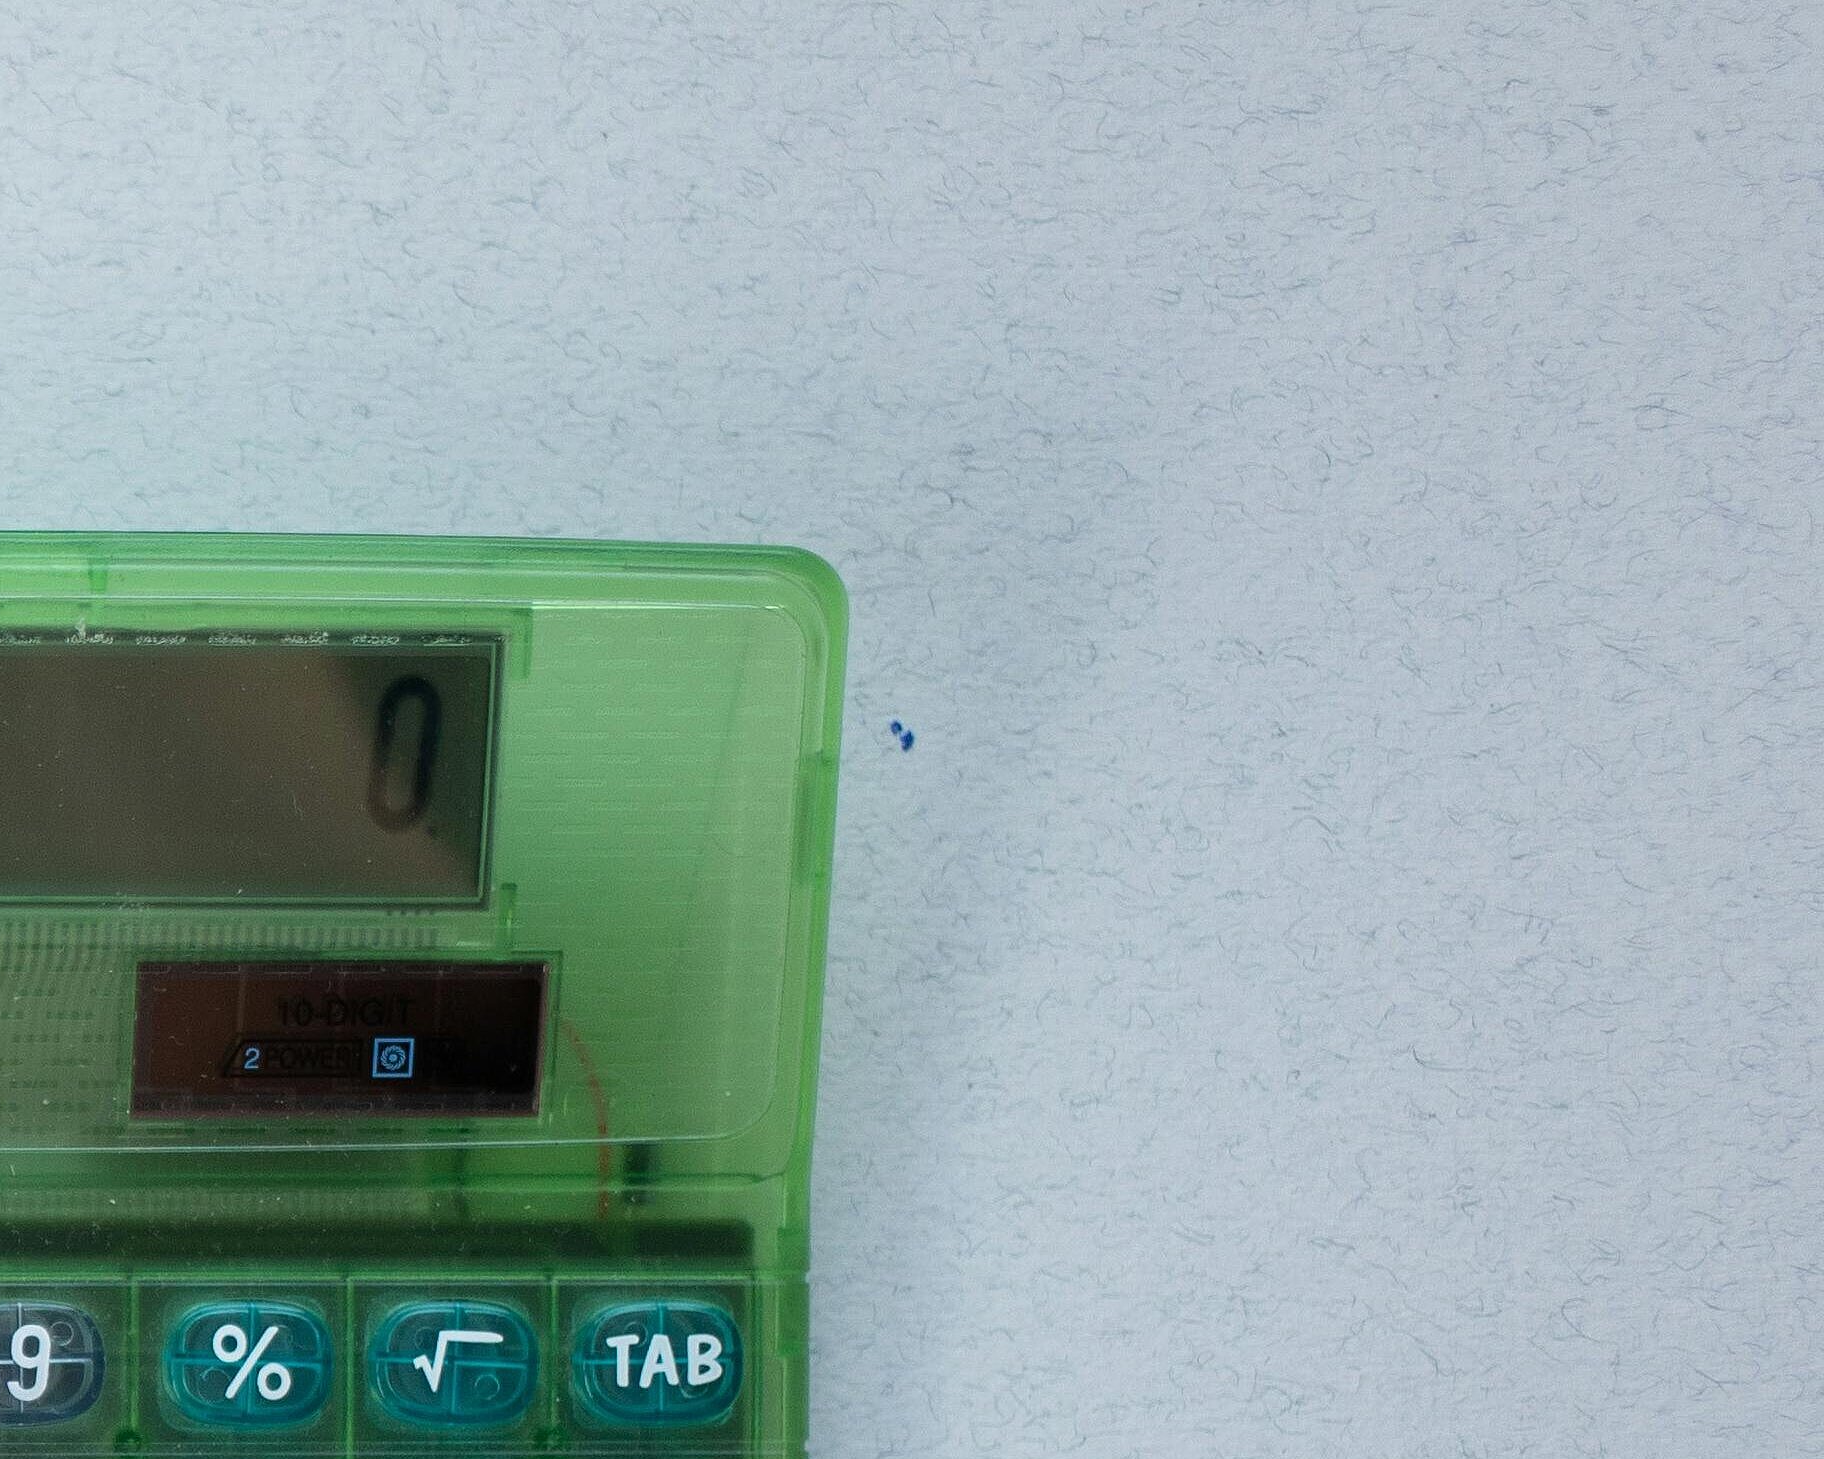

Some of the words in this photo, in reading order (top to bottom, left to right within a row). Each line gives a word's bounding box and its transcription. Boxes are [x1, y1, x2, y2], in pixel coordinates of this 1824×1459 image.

[277, 997, 414, 1027] 10-DIGIT
[243, 1045, 262, 1071] 2
[264, 1045, 353, 1071] POWER
[8, 1324, 53, 1402] 9
[606, 1333, 725, 1389] TAB
